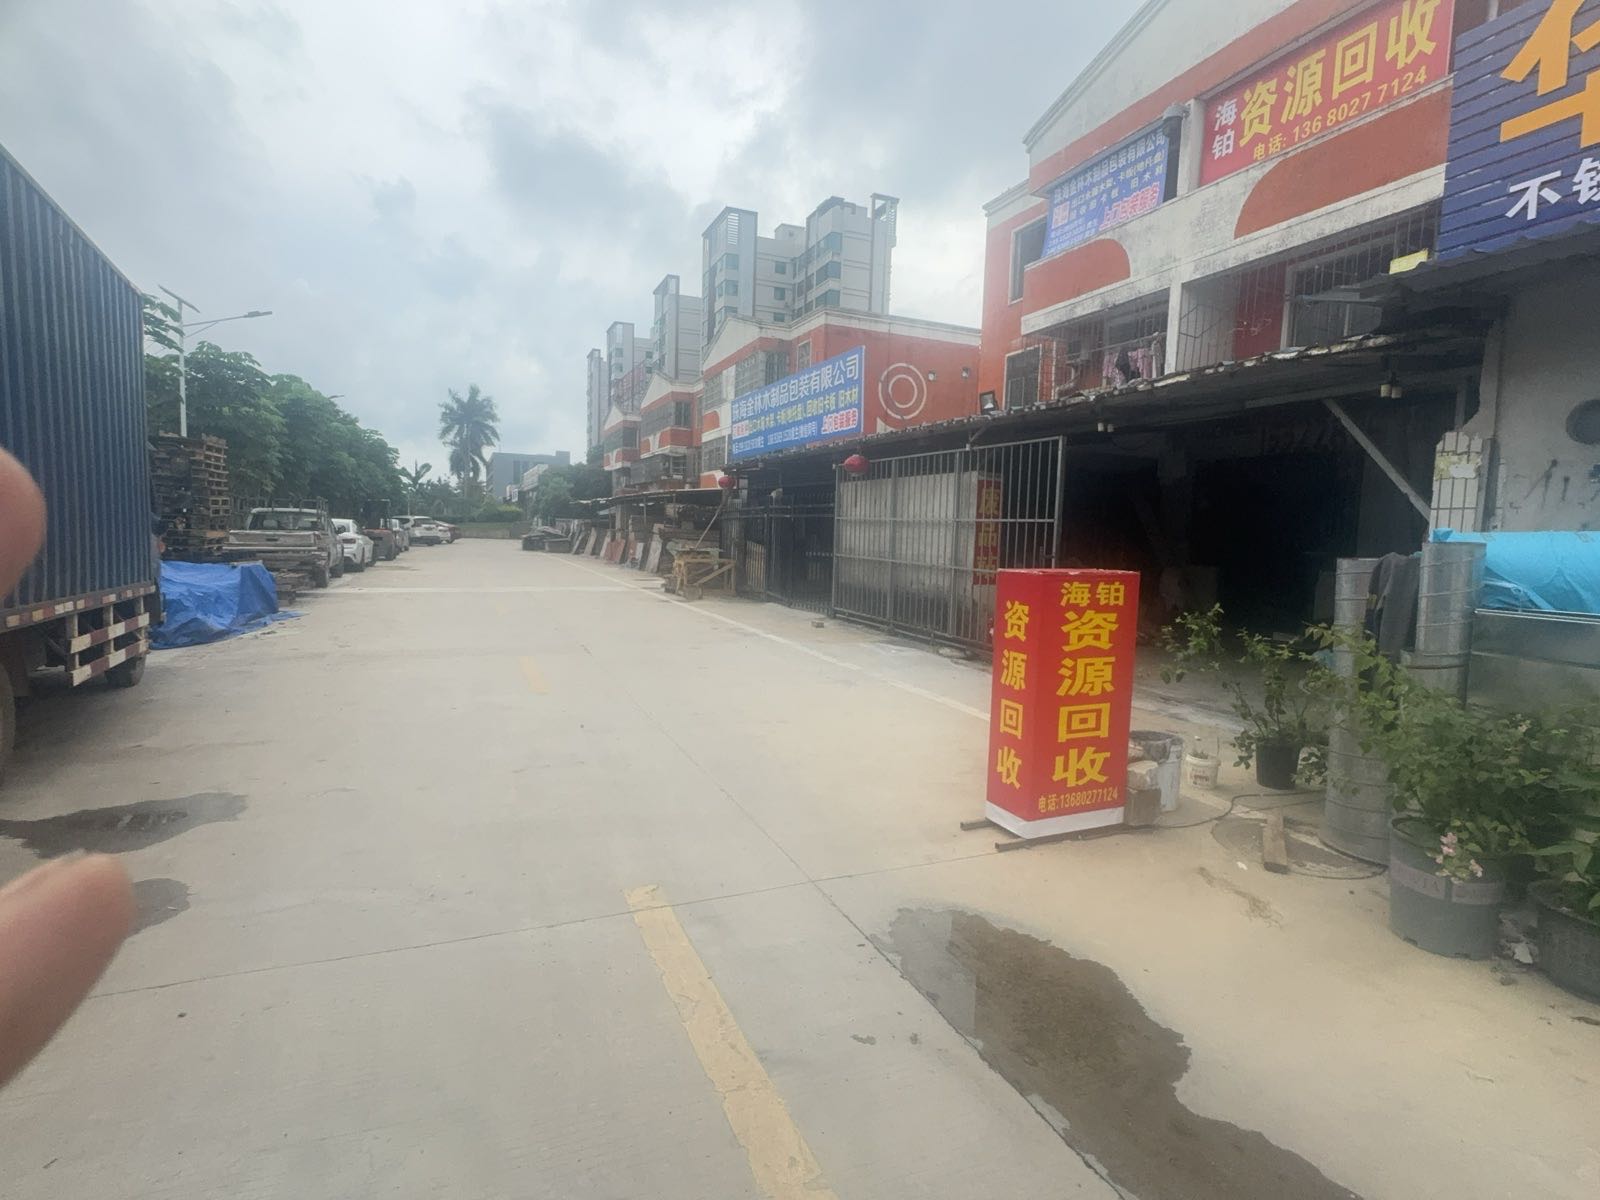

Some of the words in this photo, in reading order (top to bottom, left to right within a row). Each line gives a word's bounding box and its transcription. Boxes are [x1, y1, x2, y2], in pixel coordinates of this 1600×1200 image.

[1211, 98, 1237, 160] 海铂
[1238, 0, 1440, 146] 资源回收
[1253, 134, 1287, 161] 电话:
[1293, 119, 1322, 145] 136
[1326, 93, 1370, 127] 8027
[1378, 66, 1428, 106] 7124
[1060, 581, 1125, 608] 海铂
[996, 599, 1031, 790] 资源回收
[1052, 609, 1120, 788] 资源回收
